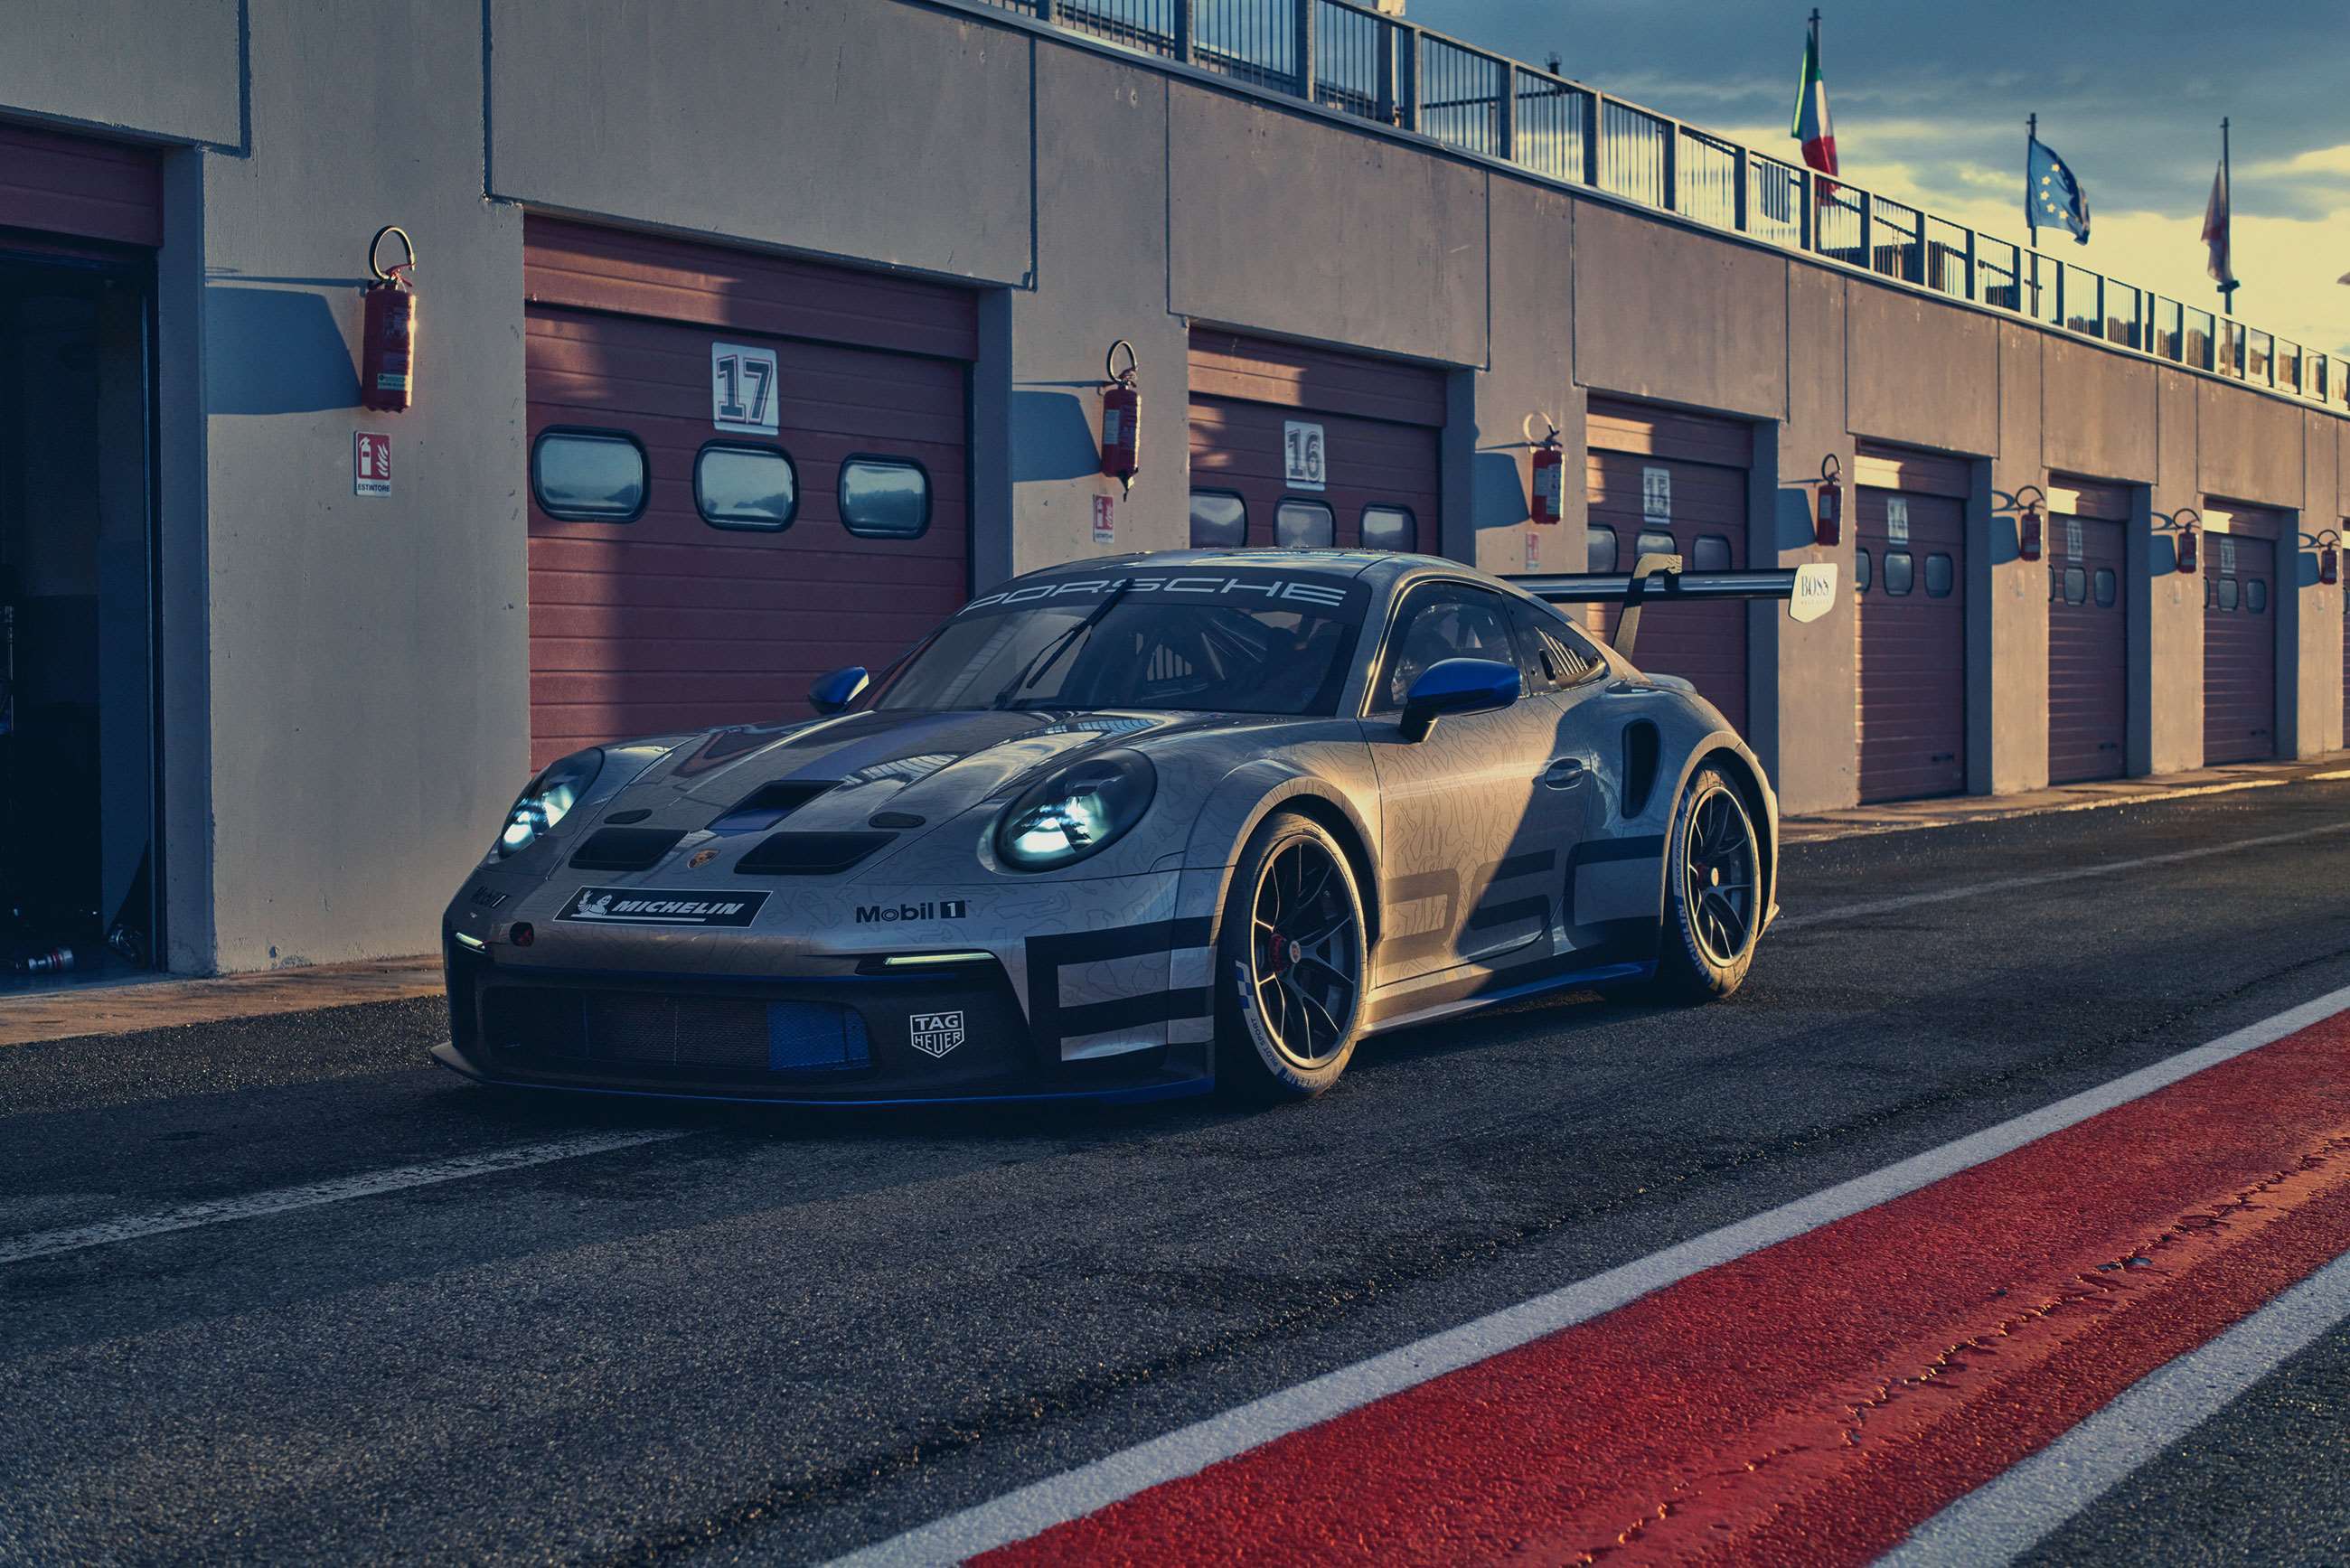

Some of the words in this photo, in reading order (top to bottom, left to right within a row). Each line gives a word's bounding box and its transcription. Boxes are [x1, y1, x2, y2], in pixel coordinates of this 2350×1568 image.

[717, 354, 773, 425] 17
[1286, 428, 1321, 482] 16
[358, 484, 390, 493] ESTINTORE
[957, 577, 1347, 616] PORSCHE
[1801, 575, 1829, 597] BOSS
[612, 900, 745, 915] MICHELIN
[855, 902, 934, 923] Mobil
[915, 1015, 959, 1030] TAG
[1250, 1017, 1265, 1047] SPORT
[915, 1032, 961, 1055] HEUER
